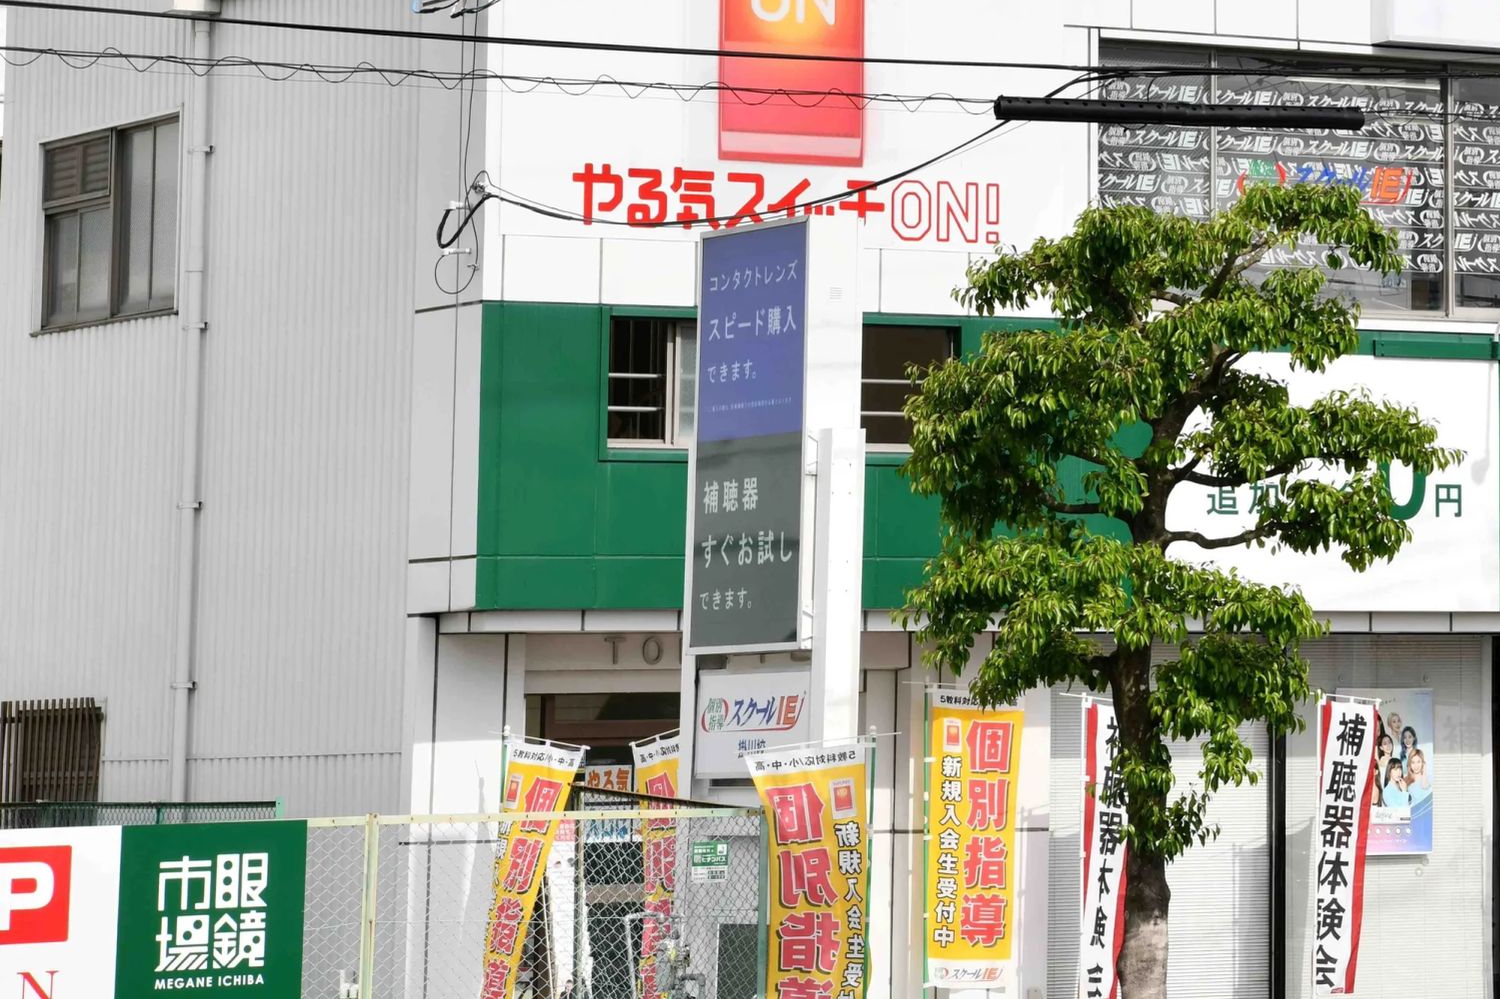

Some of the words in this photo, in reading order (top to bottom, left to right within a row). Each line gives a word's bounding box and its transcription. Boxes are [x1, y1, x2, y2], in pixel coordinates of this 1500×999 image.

[709, 260, 799, 292] コンタクトレンズ
[708, 305, 797, 342] スピード購入
[707, 358, 757, 383] できます。
[703, 477, 758, 514] 補聴器
[701, 530, 793, 568] すぐお試し
[699, 587, 752, 610] できます。
[726, 695, 799, 728] スクールIE
[587, 767, 630, 793] やる気
[959, 720, 1015, 948] 個別指導
[1317, 712, 1367, 989] 補聴器体験会
[932, 755, 964, 949] 新規入会生受付中
[154, 976, 213, 990] MEGANE
[218, 973, 264, 987] ICHIBA
